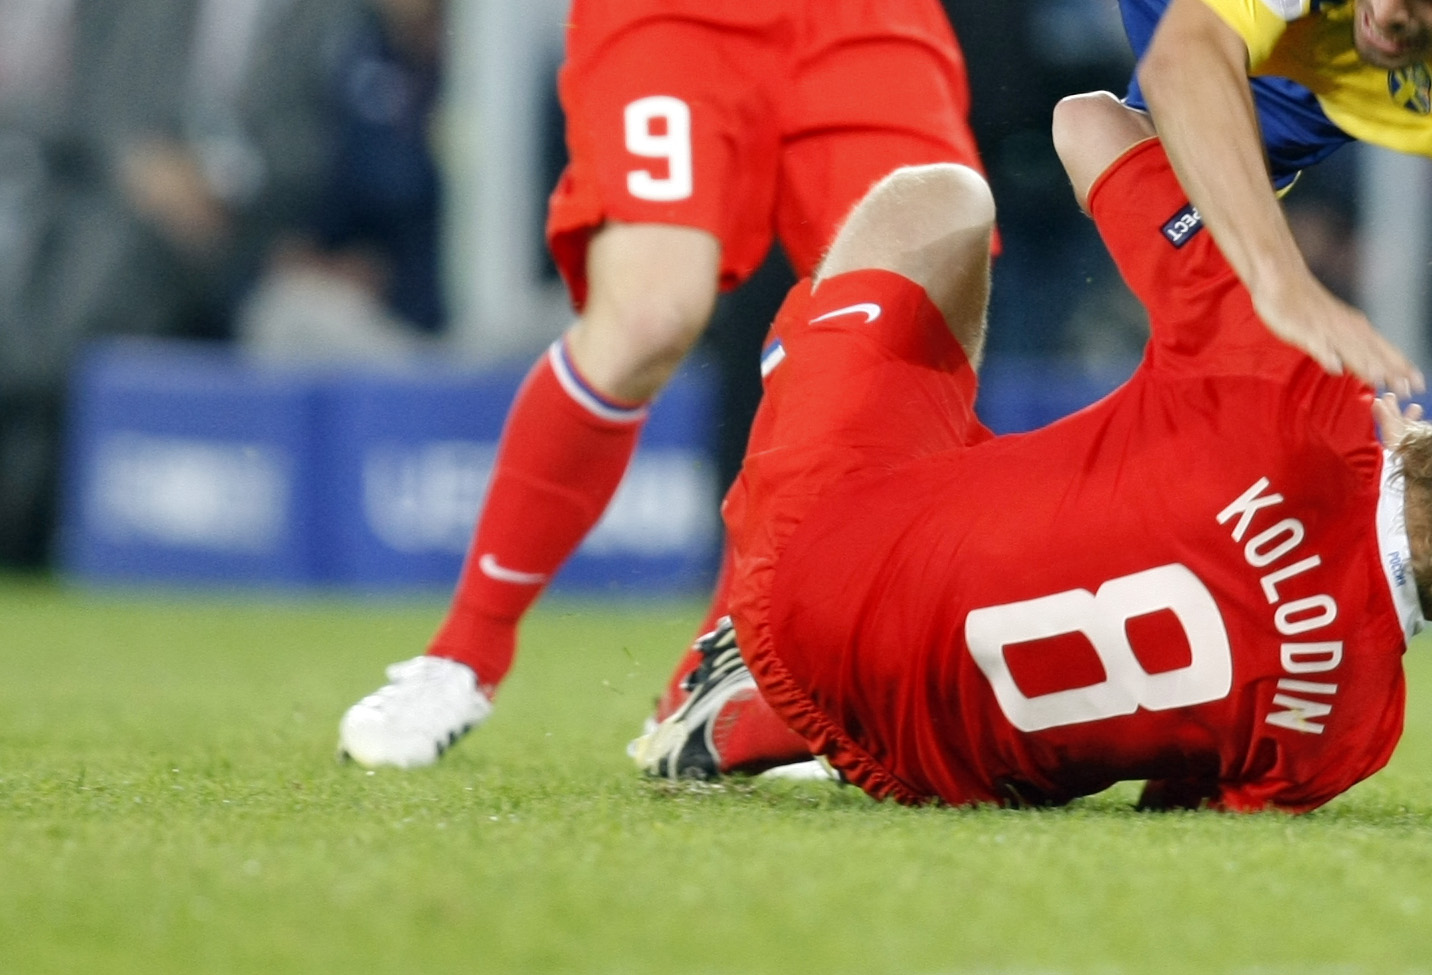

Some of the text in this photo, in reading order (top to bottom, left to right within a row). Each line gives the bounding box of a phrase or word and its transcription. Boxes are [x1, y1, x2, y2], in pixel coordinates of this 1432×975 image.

[624, 94, 693, 202] 9
[965, 562, 1232, 732] 8
[1216, 476, 1343, 735] KOLODIN
